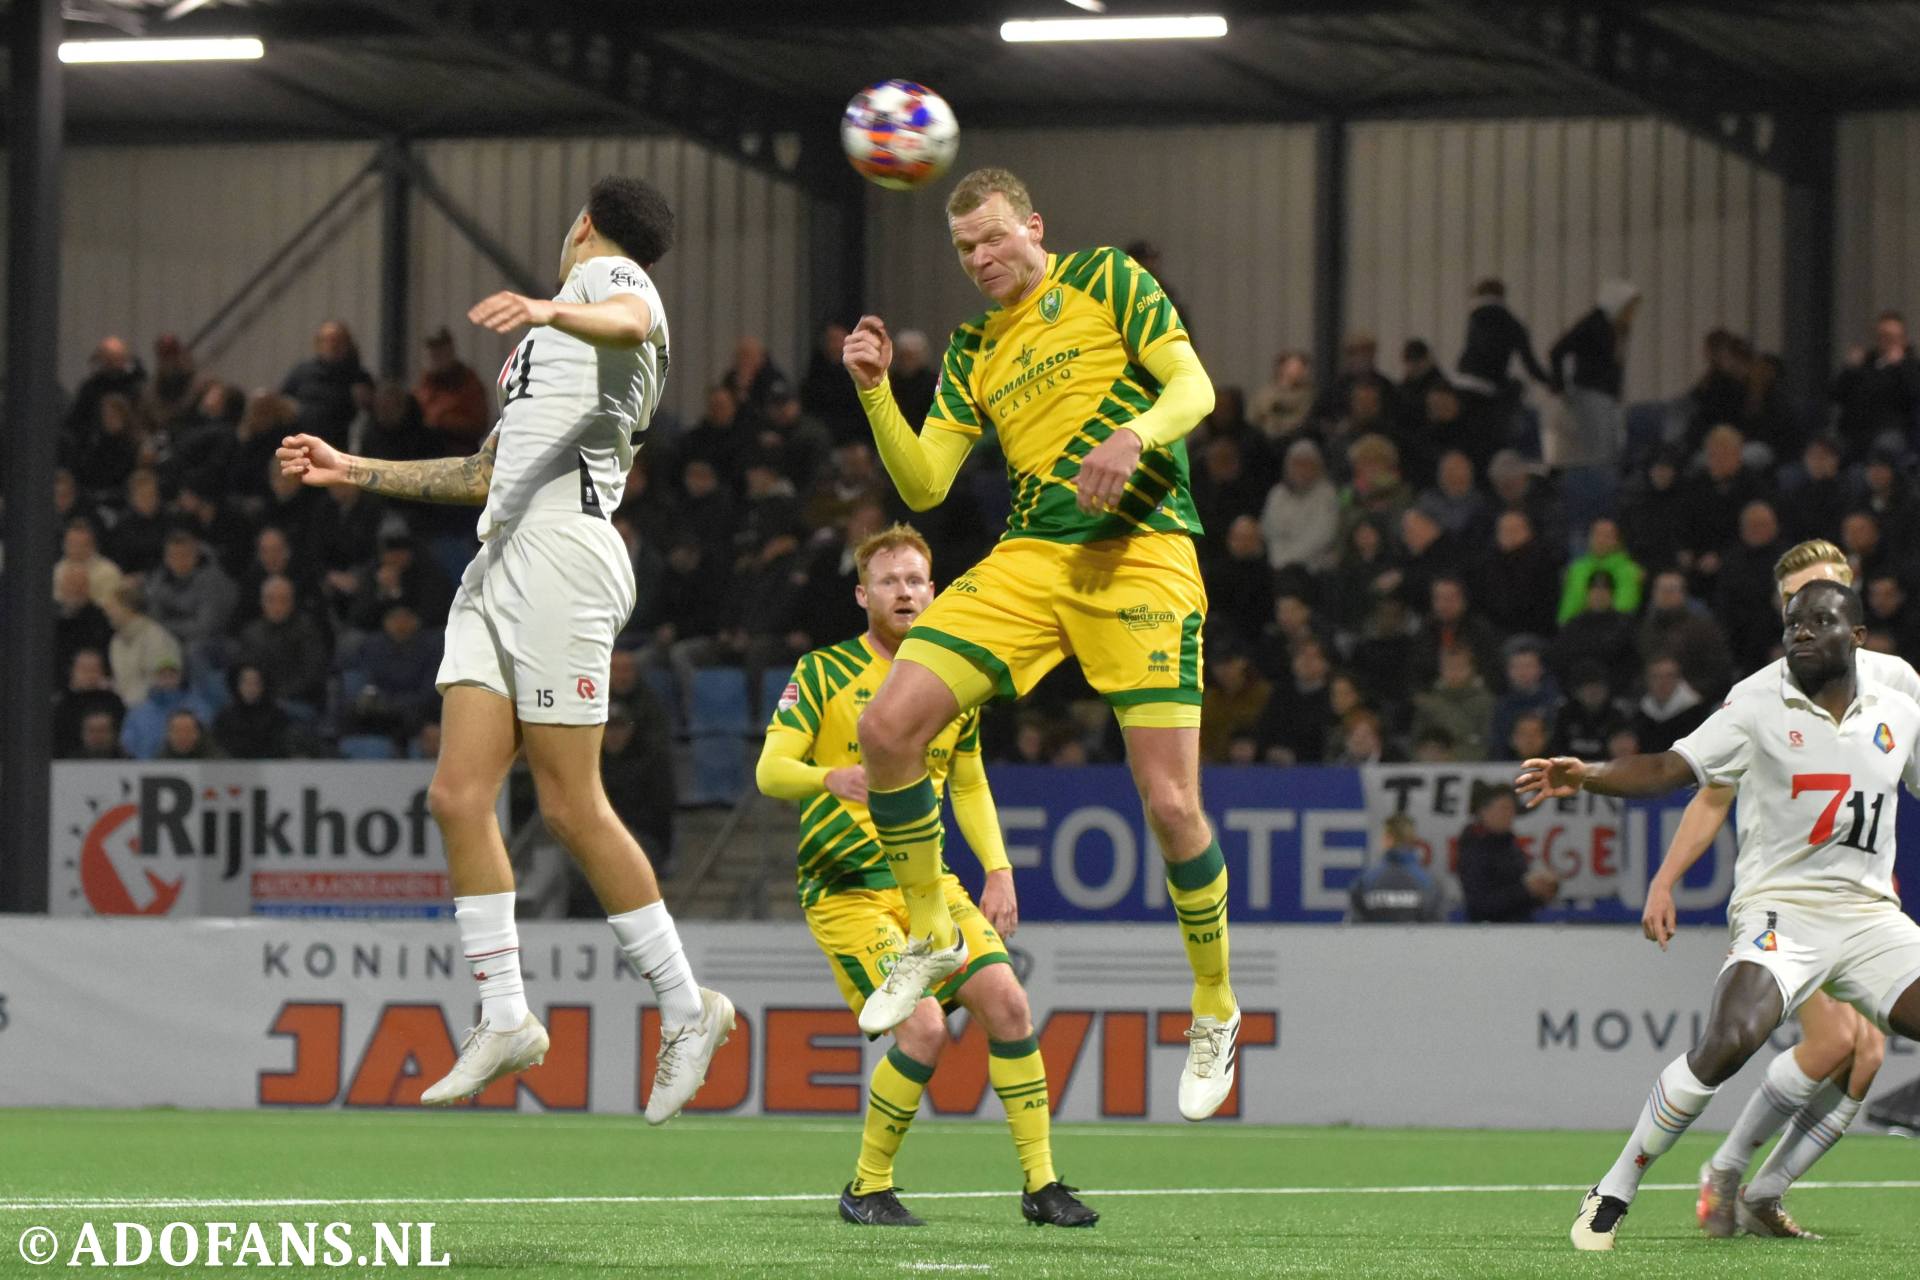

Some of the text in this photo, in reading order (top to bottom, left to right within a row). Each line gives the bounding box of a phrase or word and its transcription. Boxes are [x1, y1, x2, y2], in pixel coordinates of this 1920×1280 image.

[988, 347, 1080, 408] HOMMERSON
[999, 368, 1071, 418] CASINO
[536, 689, 554, 708] 15
[257, 1002, 594, 1114] JAN
[637, 1005, 866, 1114] DE
